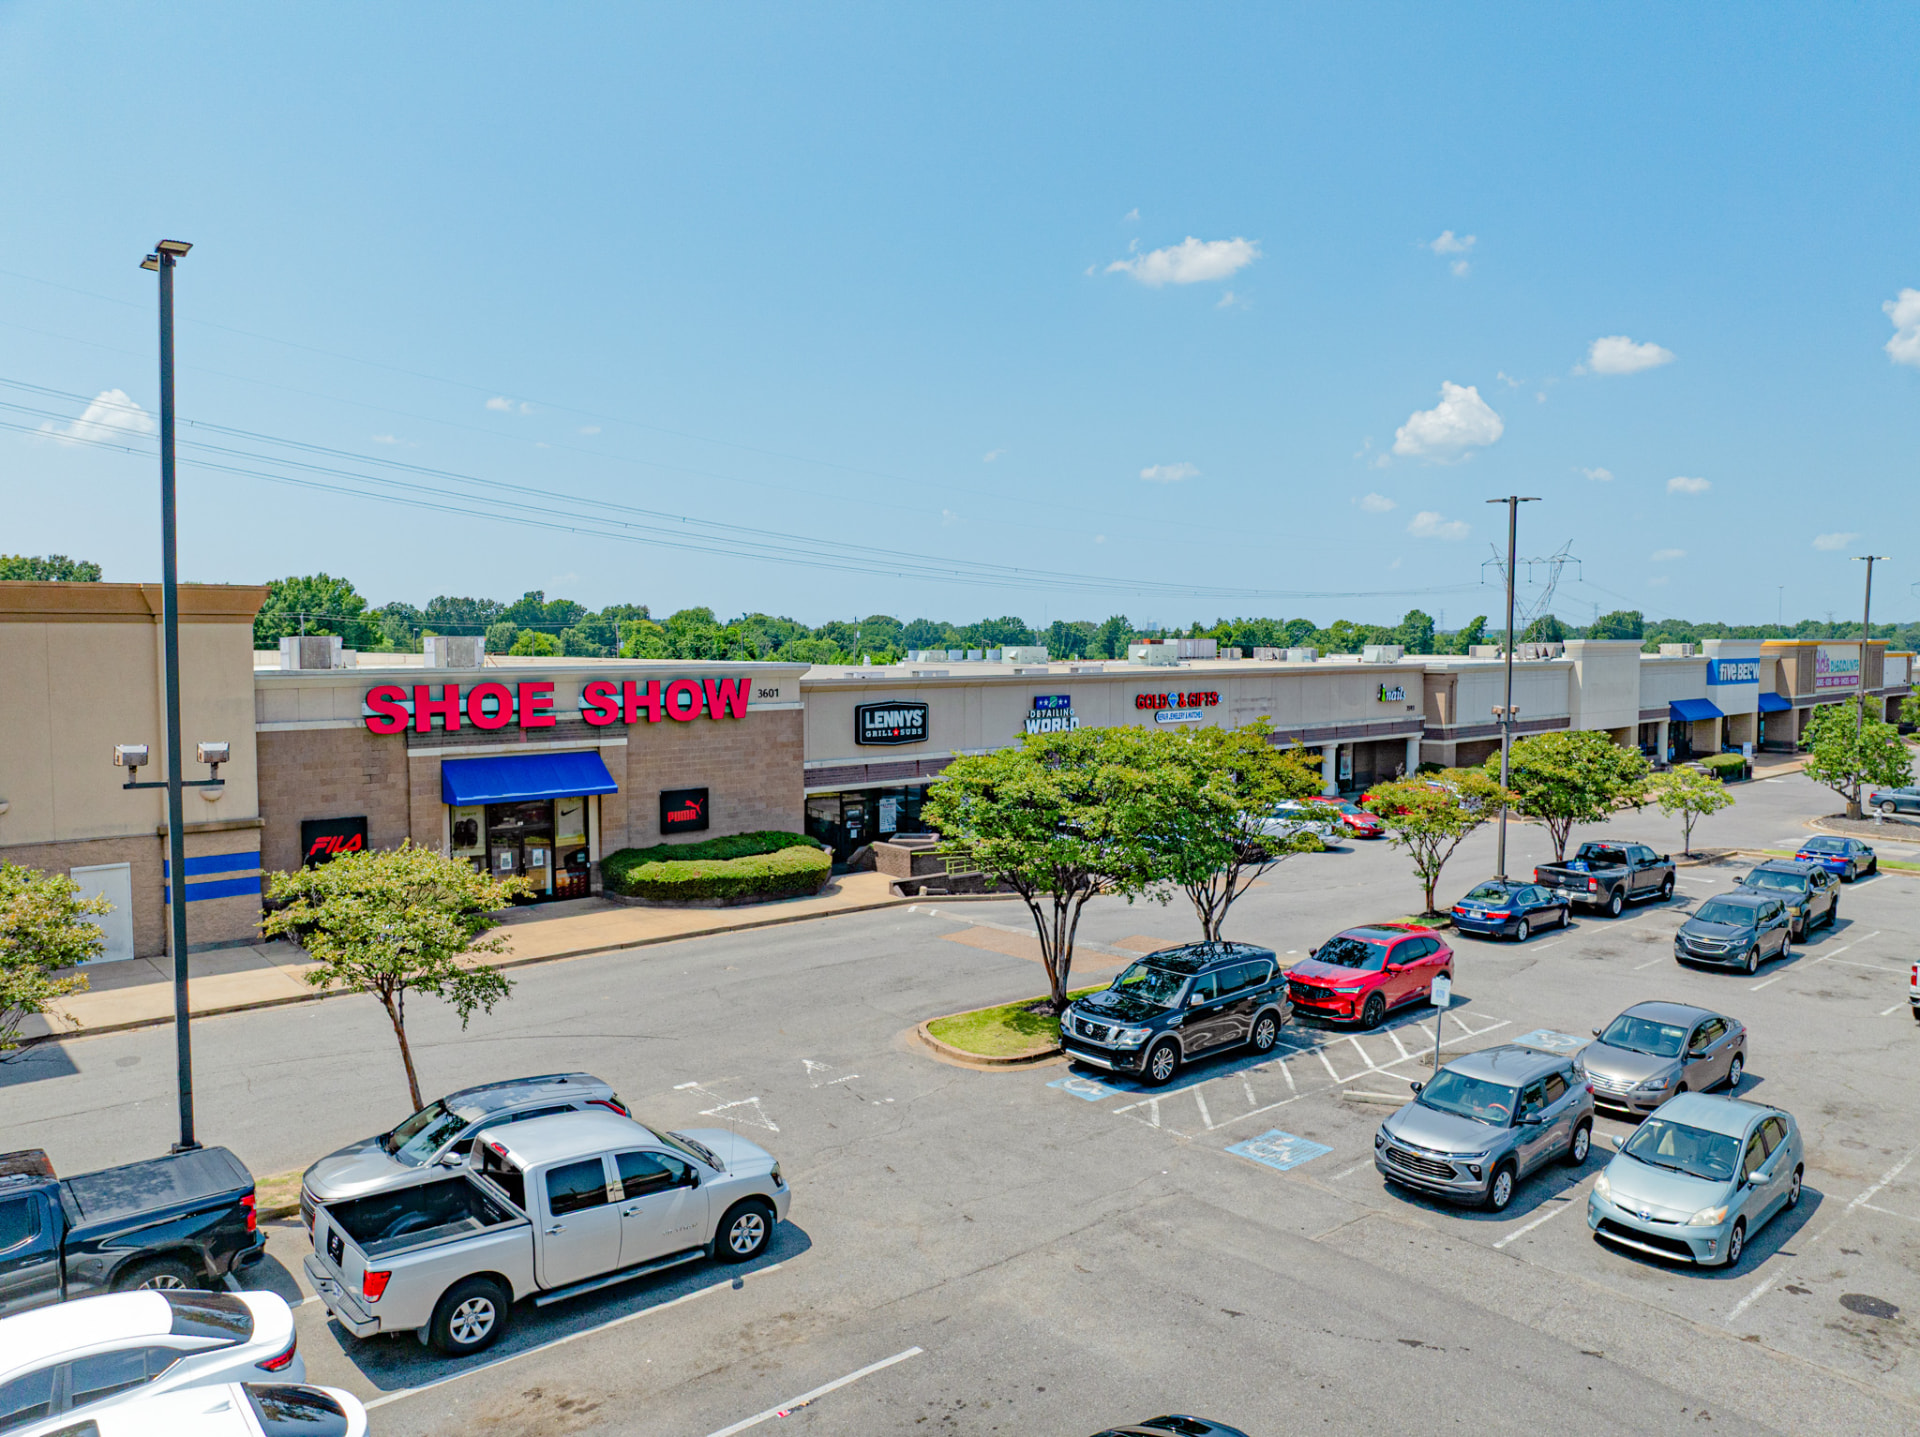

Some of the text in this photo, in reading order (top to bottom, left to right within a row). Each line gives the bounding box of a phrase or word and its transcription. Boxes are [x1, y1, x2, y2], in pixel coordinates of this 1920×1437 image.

[1720, 663, 1737, 681] five
[757, 687, 779, 699] 3601
[1136, 691, 1218, 709] GOLD & GIFTS
[365, 678, 752, 734] SHOE SHOW
[1029, 708, 1075, 718] DETAILING
[865, 709, 922, 729] LENNYS
[1025, 717, 1080, 735] WORLD
[865, 727, 923, 737] GRILL SUBS
[667, 809, 697, 823] PUMA
[309, 833, 362, 856] FILA
